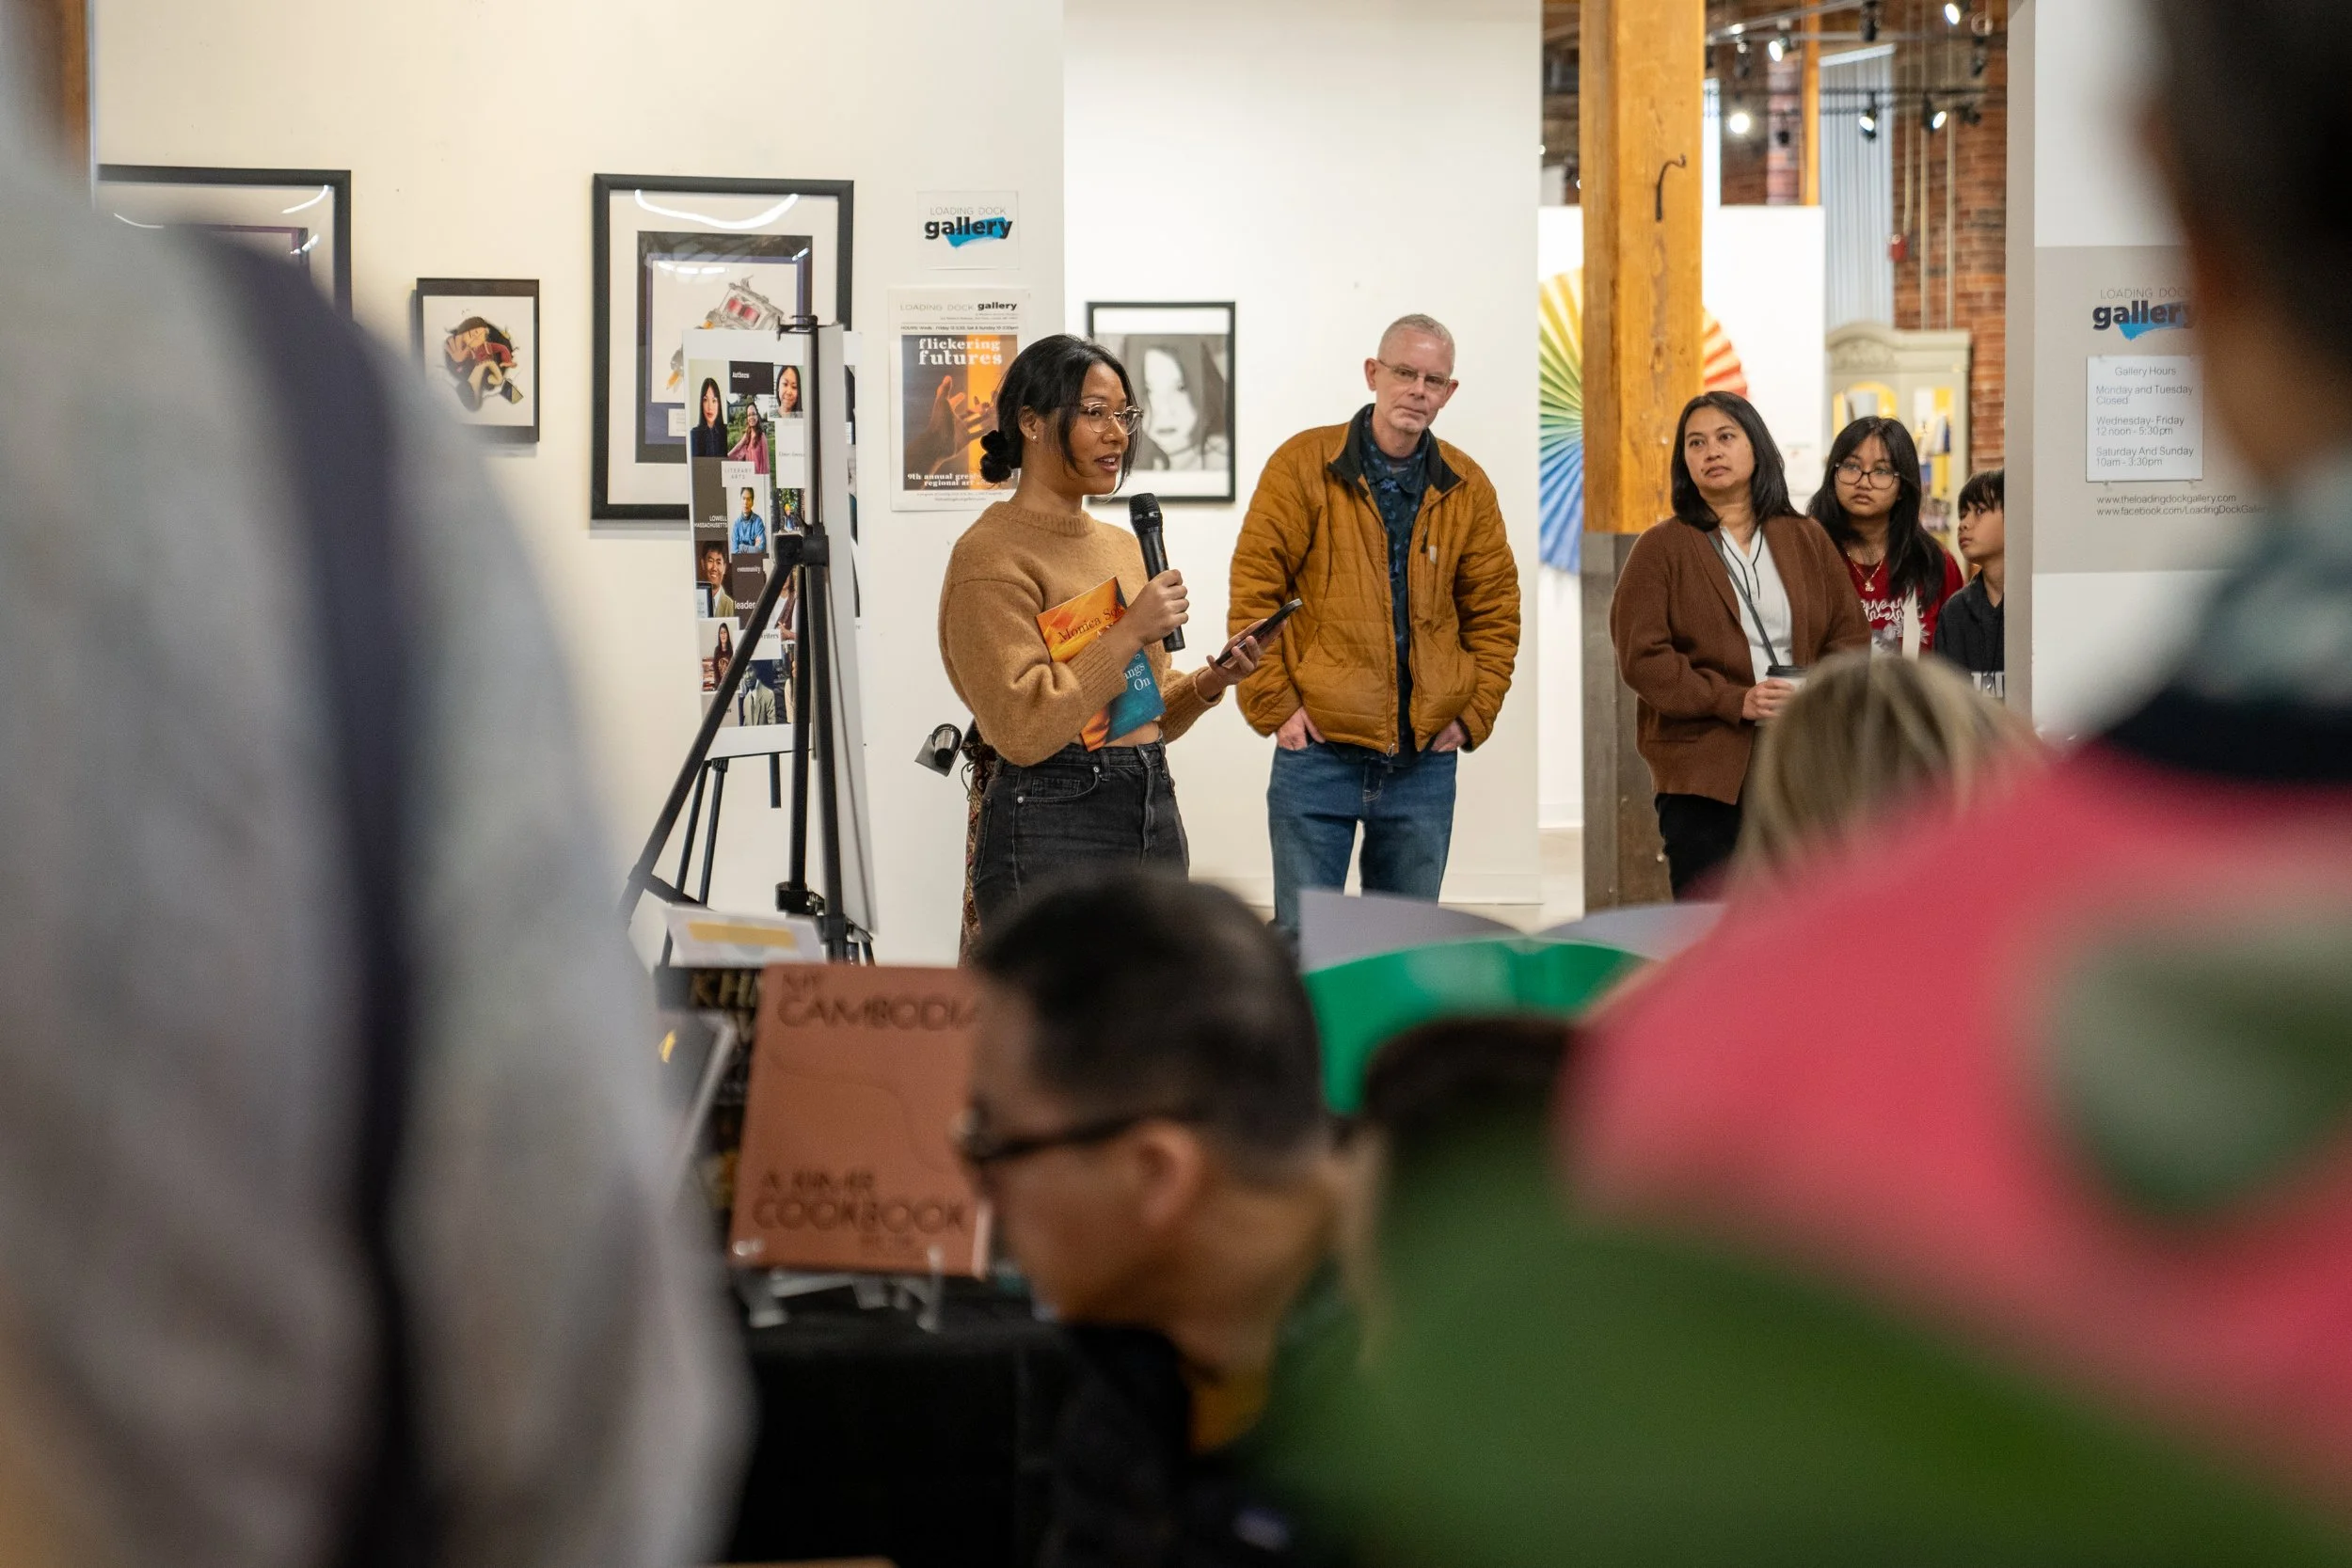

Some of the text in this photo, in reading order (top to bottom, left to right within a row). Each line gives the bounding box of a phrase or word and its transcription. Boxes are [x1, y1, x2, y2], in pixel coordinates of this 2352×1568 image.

[930, 207, 1007, 215] LOADING DOCK
[924, 216, 1013, 240] gallery
[2100, 287, 2193, 300] LOADING DOC
[977, 301, 1017, 311] gallery
[918, 338, 1000, 352] flickering
[918, 351, 1003, 366] futures
[2115, 366, 2176, 377] Gallery Hours
[2096, 385, 2193, 396] Monday and Tuesday
[2096, 396, 2128, 405] Closed
[2156, 416, 2185, 426] Friday
[2108, 427, 2131, 436] noon
[2138, 426, 2173, 436] 5:30pm
[2096, 446, 2194, 457] Saturday And Sunday
[2096, 457, 2121, 467] 10am
[2128, 457, 2163, 467] 3:30pm
[2096, 494, 2236, 505] www.theloadingdockgallery.com
[1058, 616, 1101, 642] Monica
[1123, 661, 1146, 681] angs
[1134, 676, 1151, 691] On
